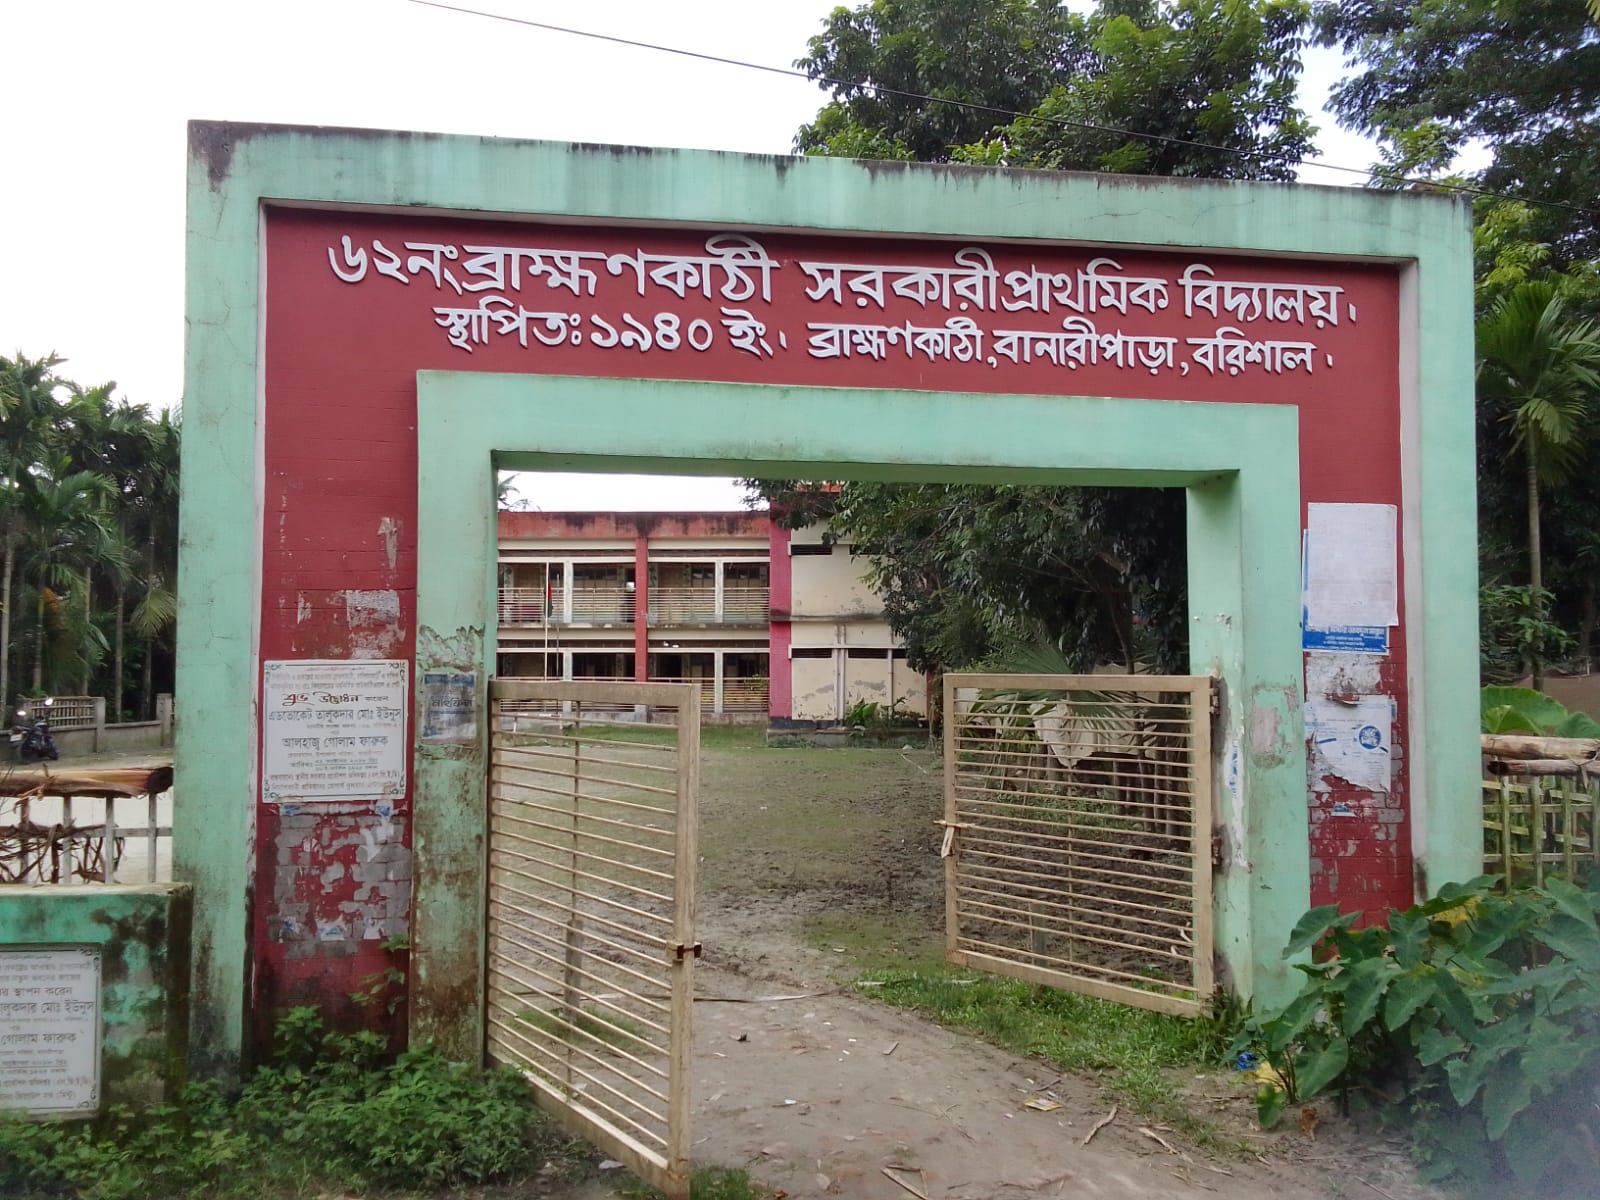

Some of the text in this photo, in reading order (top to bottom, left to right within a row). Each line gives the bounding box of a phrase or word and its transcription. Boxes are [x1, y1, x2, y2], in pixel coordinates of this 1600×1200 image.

[799, 247, 1000, 311] সরকারী
[1000, 257, 1168, 315] প্রাথমিক
[590, 312, 714, 352] ১৯৪০
